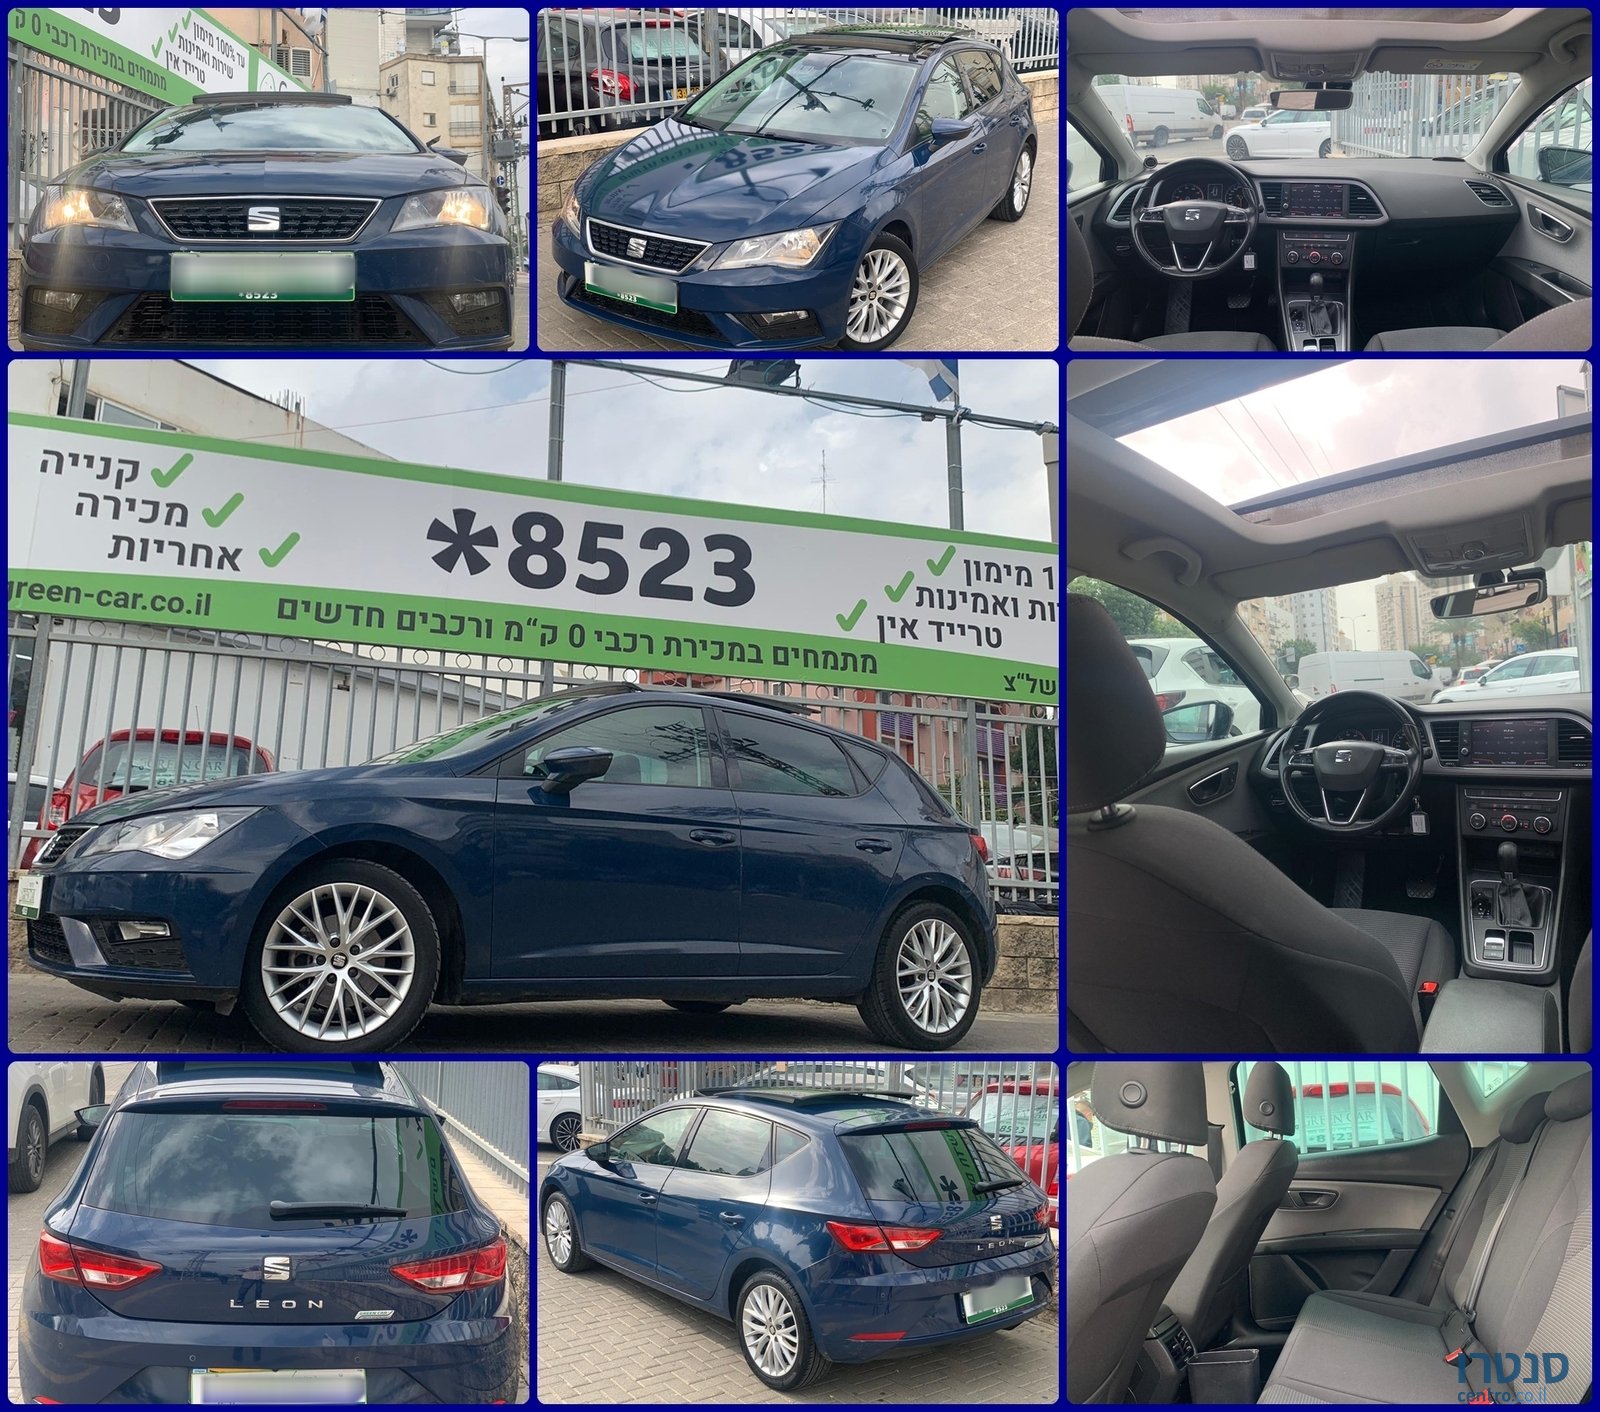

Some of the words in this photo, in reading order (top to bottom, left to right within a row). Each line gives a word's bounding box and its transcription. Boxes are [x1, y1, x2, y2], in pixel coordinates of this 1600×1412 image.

[32, 13, 41, 36] 0
[45, 22, 77, 52] רכבי
[193, 21, 214, 48] מימון
[81, 38, 125, 73] במכירת
[165, 49, 180, 71] אין
[178, 34, 210, 66] ואמינות
[216, 38, 236, 62] 100%
[236, 51, 246, 68] עד
[127, 60, 167, 91] מתמחים
[182, 59, 206, 84] טרייד
[211, 55, 234, 79] שירות
[40, 449, 140, 490] קנייה
[75, 492, 189, 528] מכירה
[107, 534, 243, 572] אחריות
[963, 559, 1033, 588] מימון
[277, 598, 385, 629] חדשים
[915, 586, 1020, 618] ואמינות
[397, 609, 493, 639] ורכבים
[568, 623, 586, 649] 0
[876, 615, 919, 644] אין
[928, 620, 1003, 649] טרייד
[594, 629, 654, 655] רכבי
[663, 636, 764, 664] במכירת
[772, 645, 878, 674] מתמחים
[977, 1239, 1016, 1251] LEON
[229, 1298, 324, 1309] LEON
